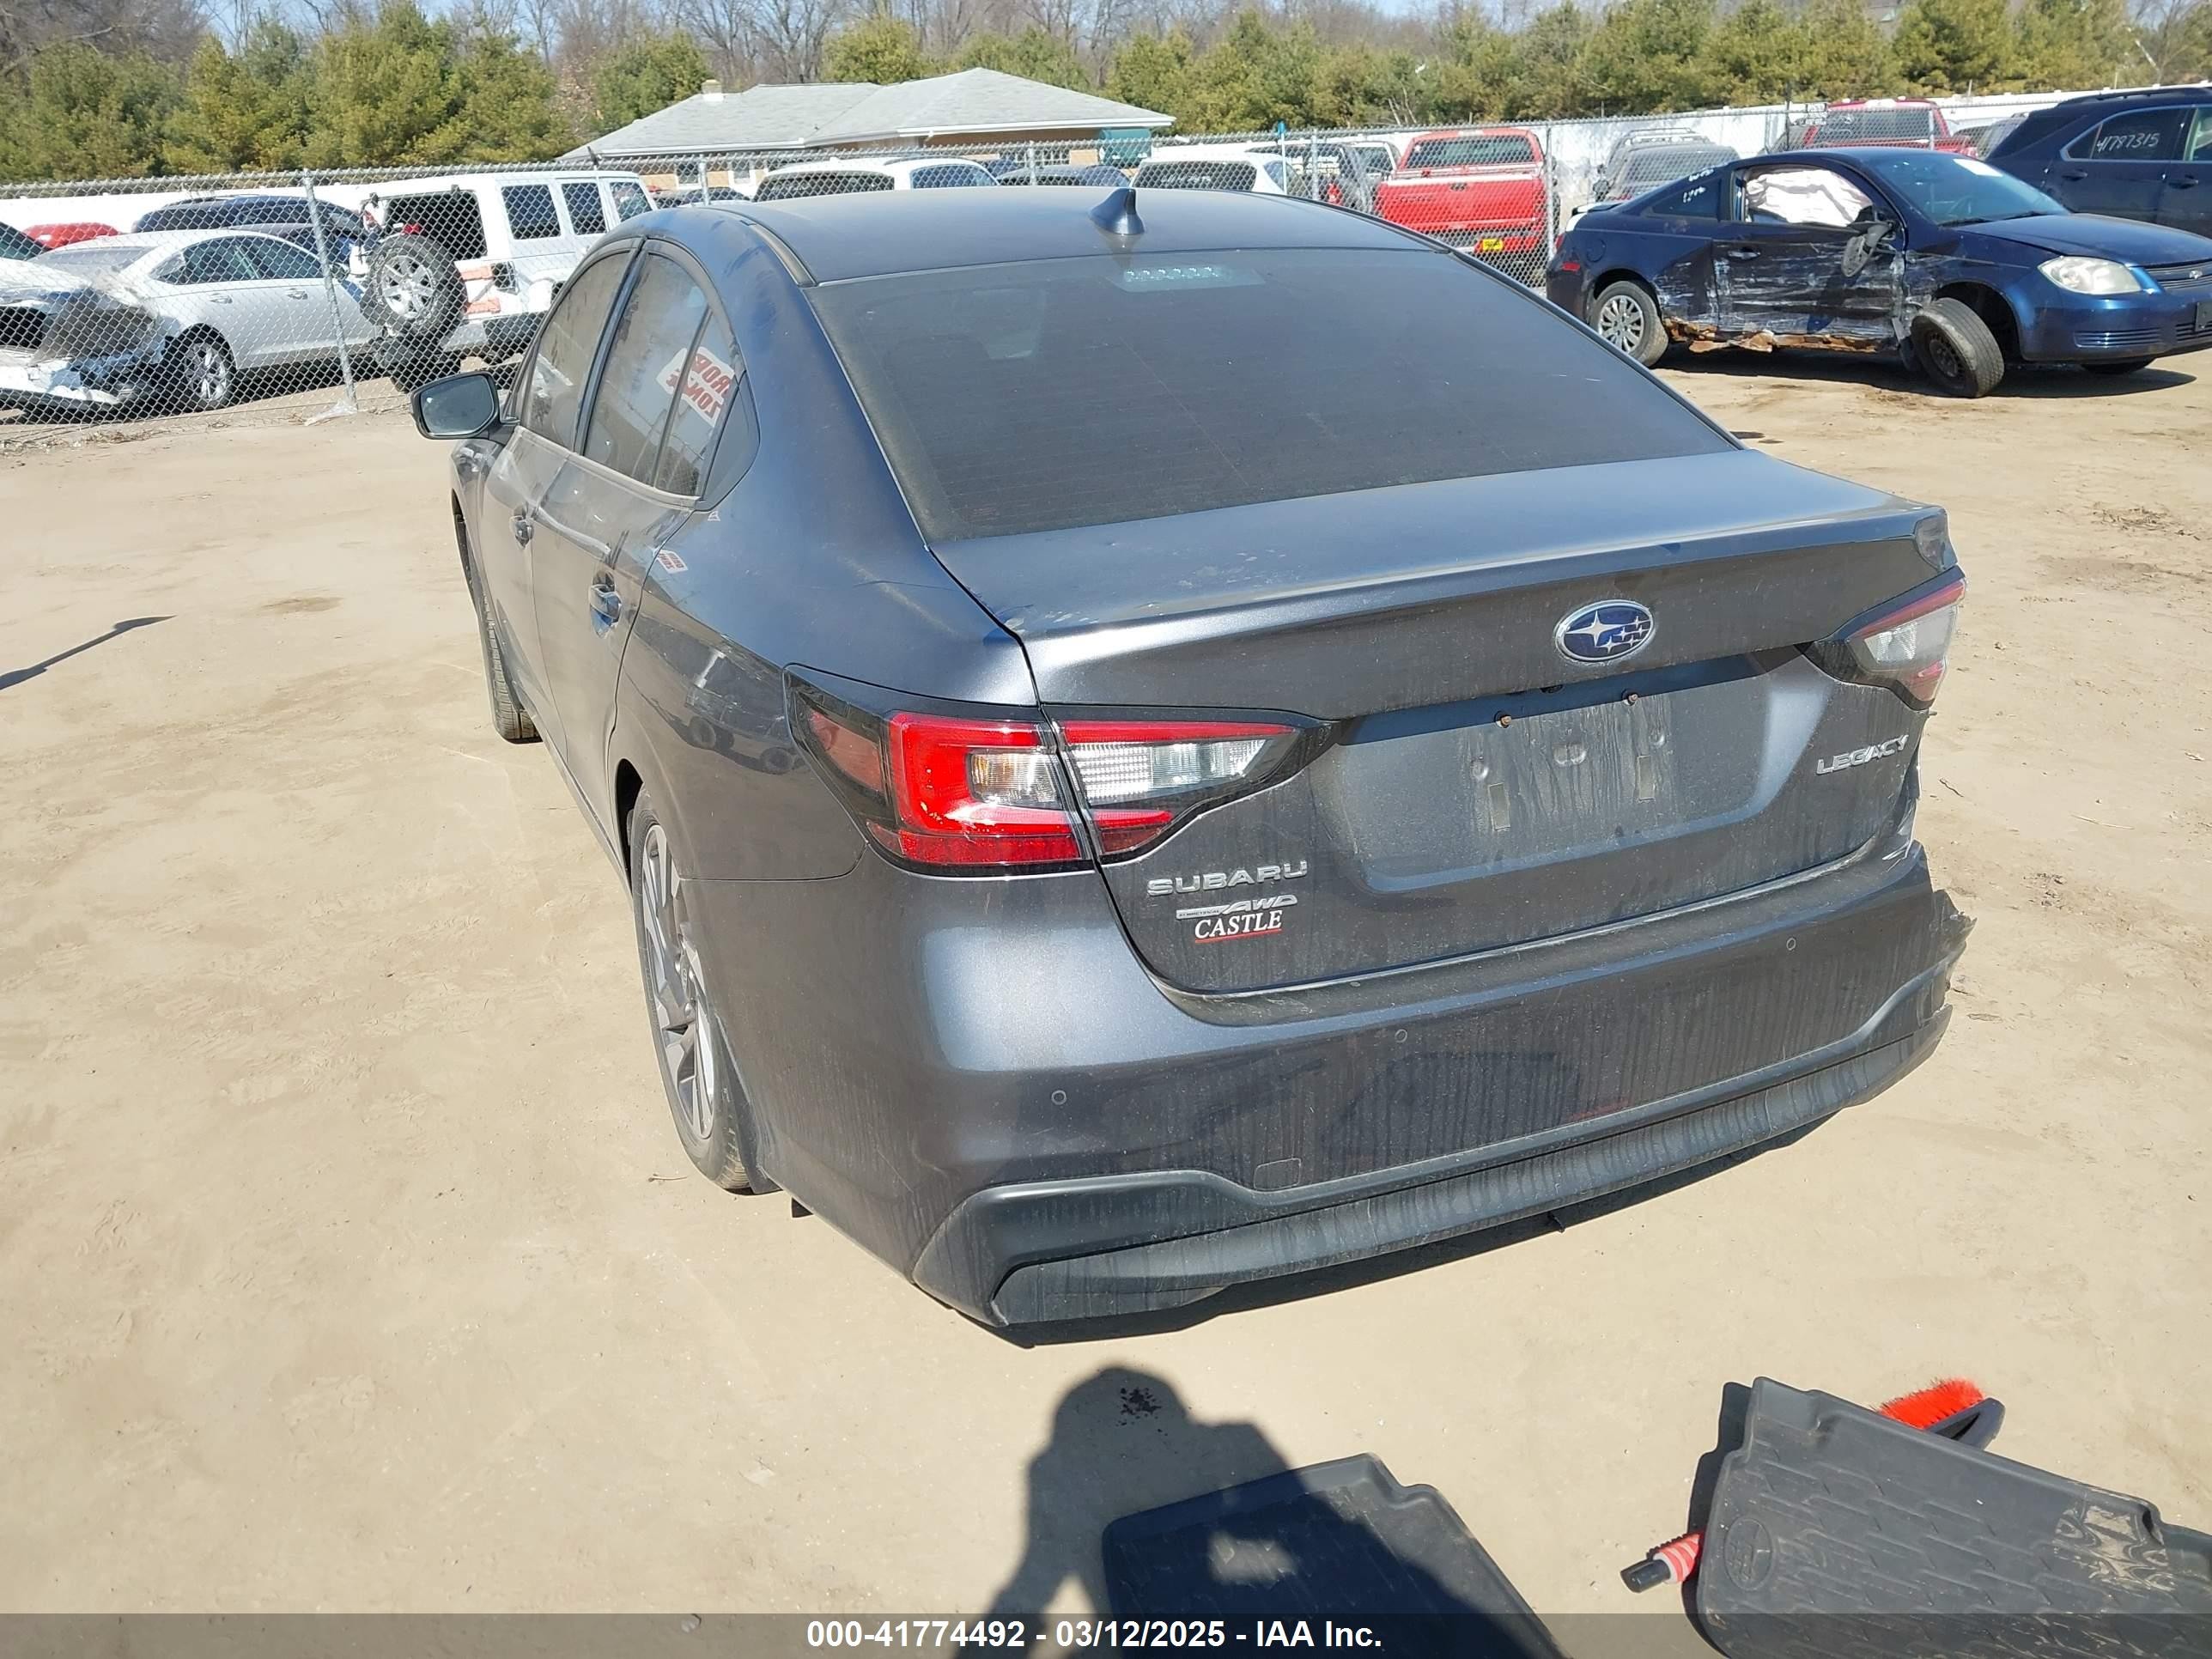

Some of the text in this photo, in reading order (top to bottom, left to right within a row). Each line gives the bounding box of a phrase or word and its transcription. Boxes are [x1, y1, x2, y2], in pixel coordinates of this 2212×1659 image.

[1817, 734, 1909, 775] LEGACY
[1147, 860, 1307, 896] SUBARU
[1223, 894, 1297, 915] AWD
[1194, 910, 1282, 939] CASTLE
